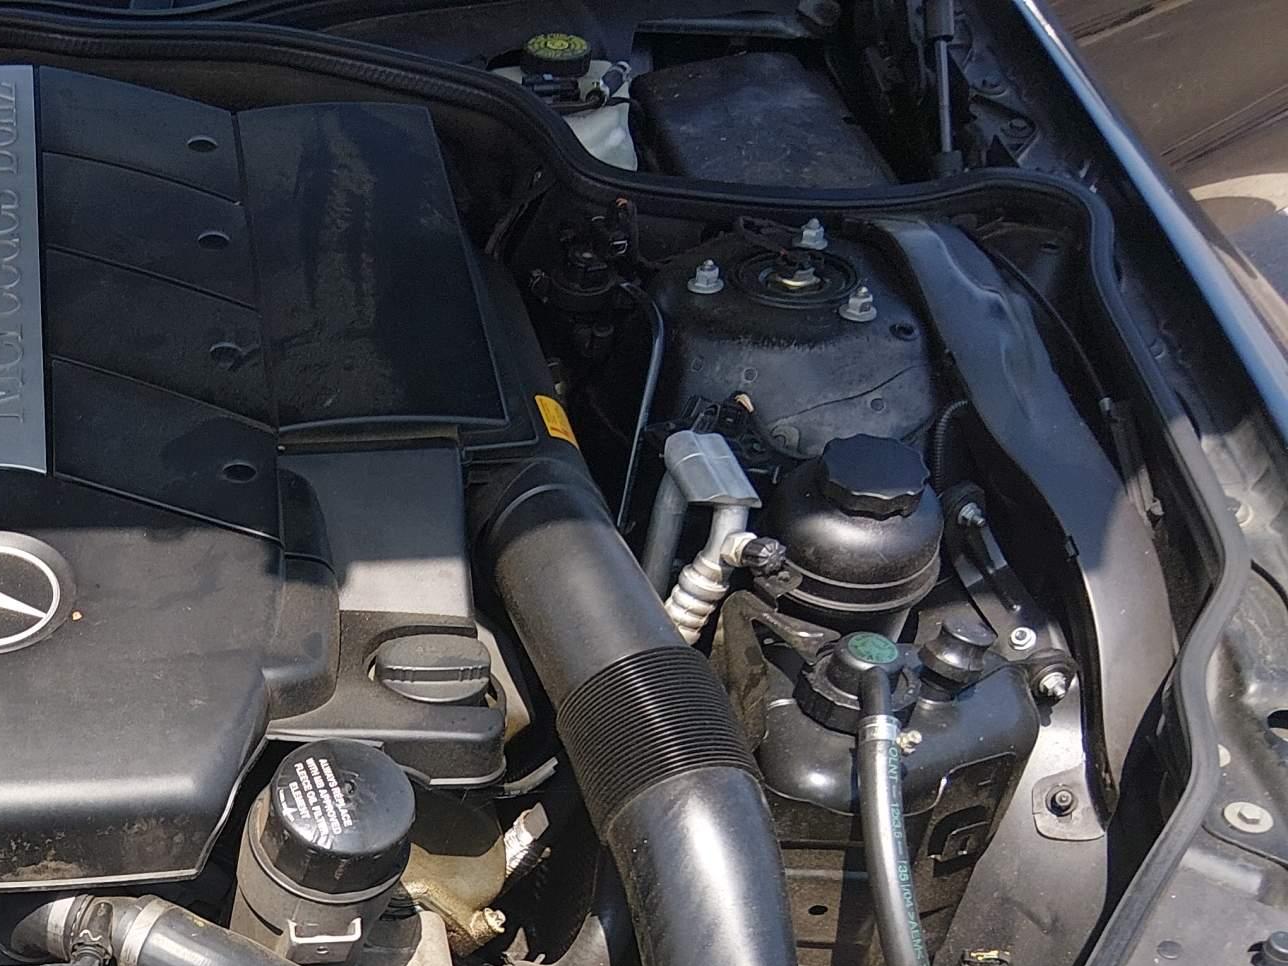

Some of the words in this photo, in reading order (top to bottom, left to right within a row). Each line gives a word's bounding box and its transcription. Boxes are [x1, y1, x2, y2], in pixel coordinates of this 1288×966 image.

[294, 762, 312, 791] FLEECE
[318, 758, 338, 787] ALWAYS
[331, 785, 353, 828] REPLACE
[288, 781, 311, 819] ELEMENT
[305, 757, 319, 776] WITH
[318, 788, 342, 835] APPROVED
[306, 790, 318, 806] OIL
[311, 804, 330, 837] FILTER
